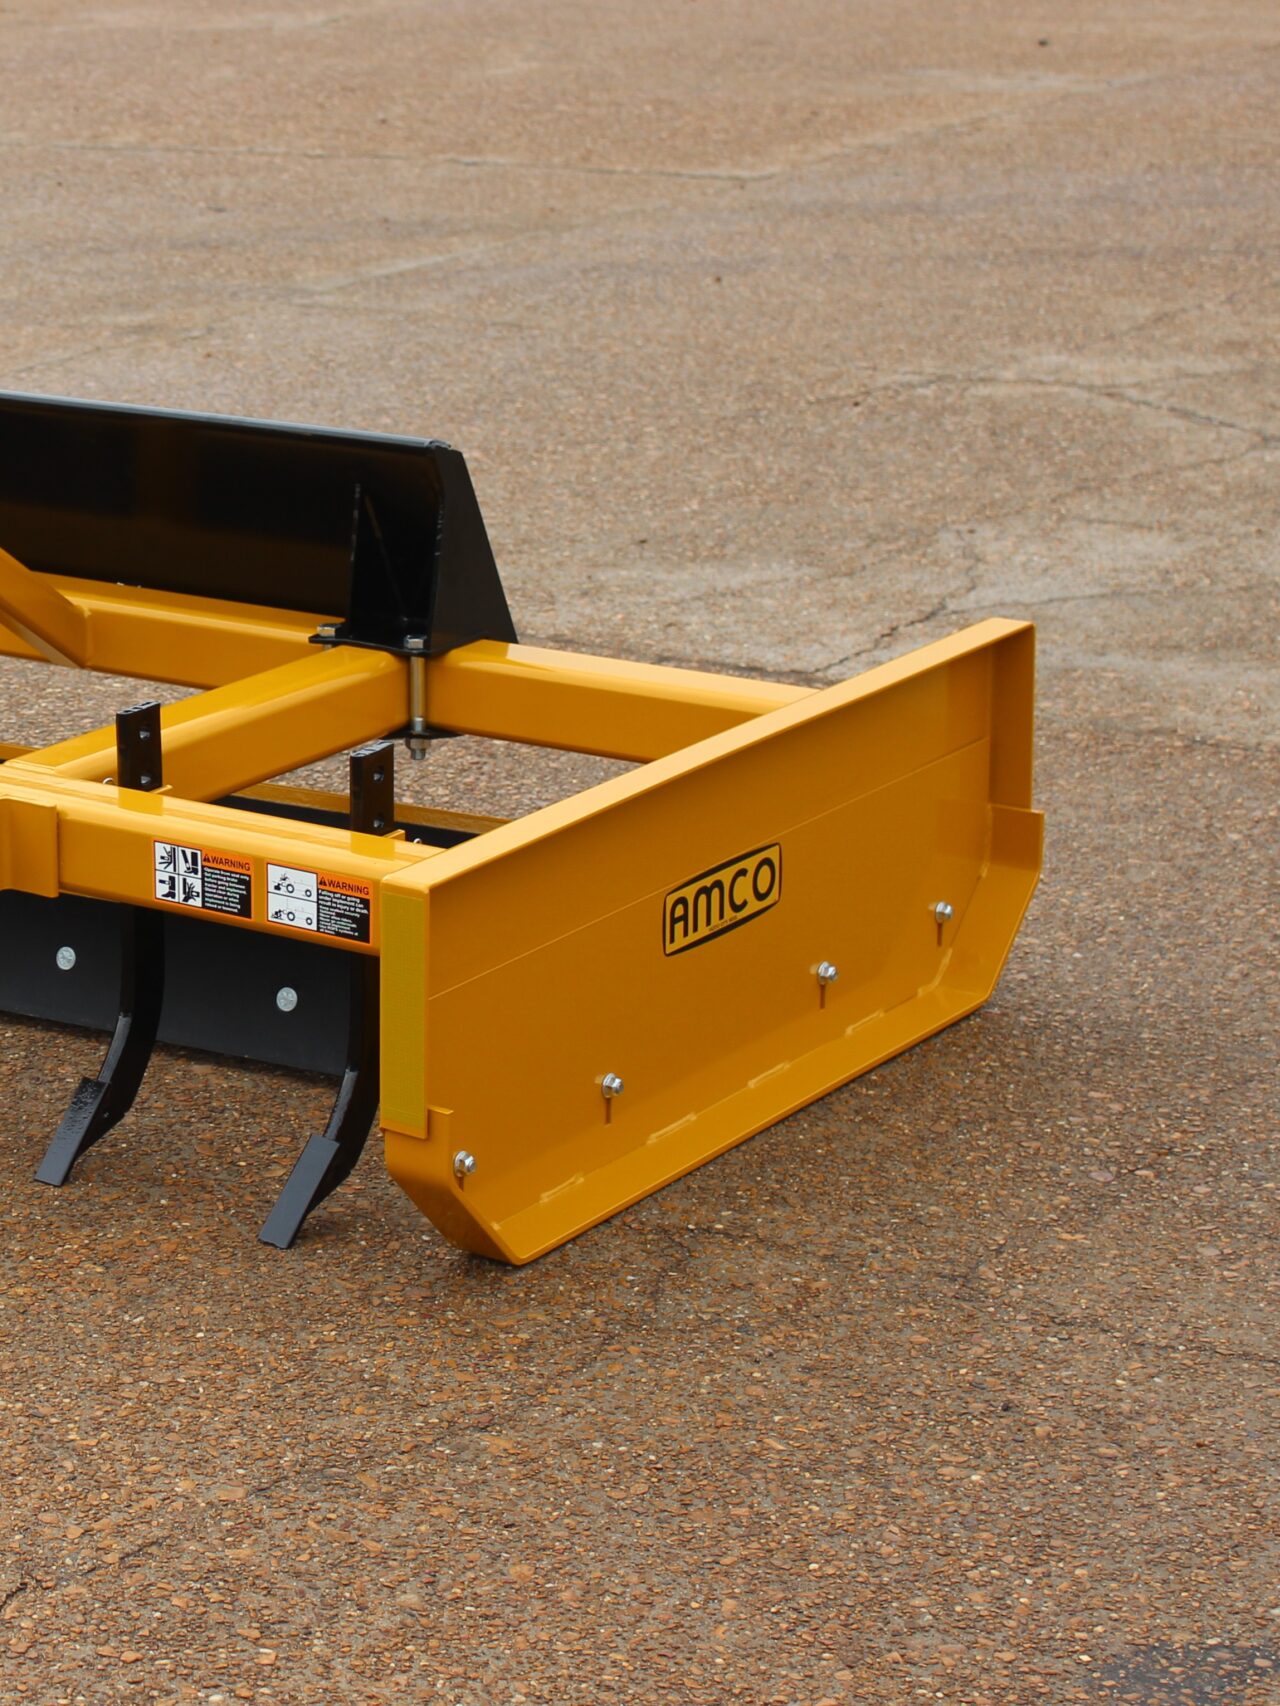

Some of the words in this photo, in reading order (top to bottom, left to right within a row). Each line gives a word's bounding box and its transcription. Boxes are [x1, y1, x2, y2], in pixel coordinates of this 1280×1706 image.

[211, 856, 250, 871] WARNING
[328, 879, 369, 895] WARNING
[669, 857, 776, 945] AMCO
